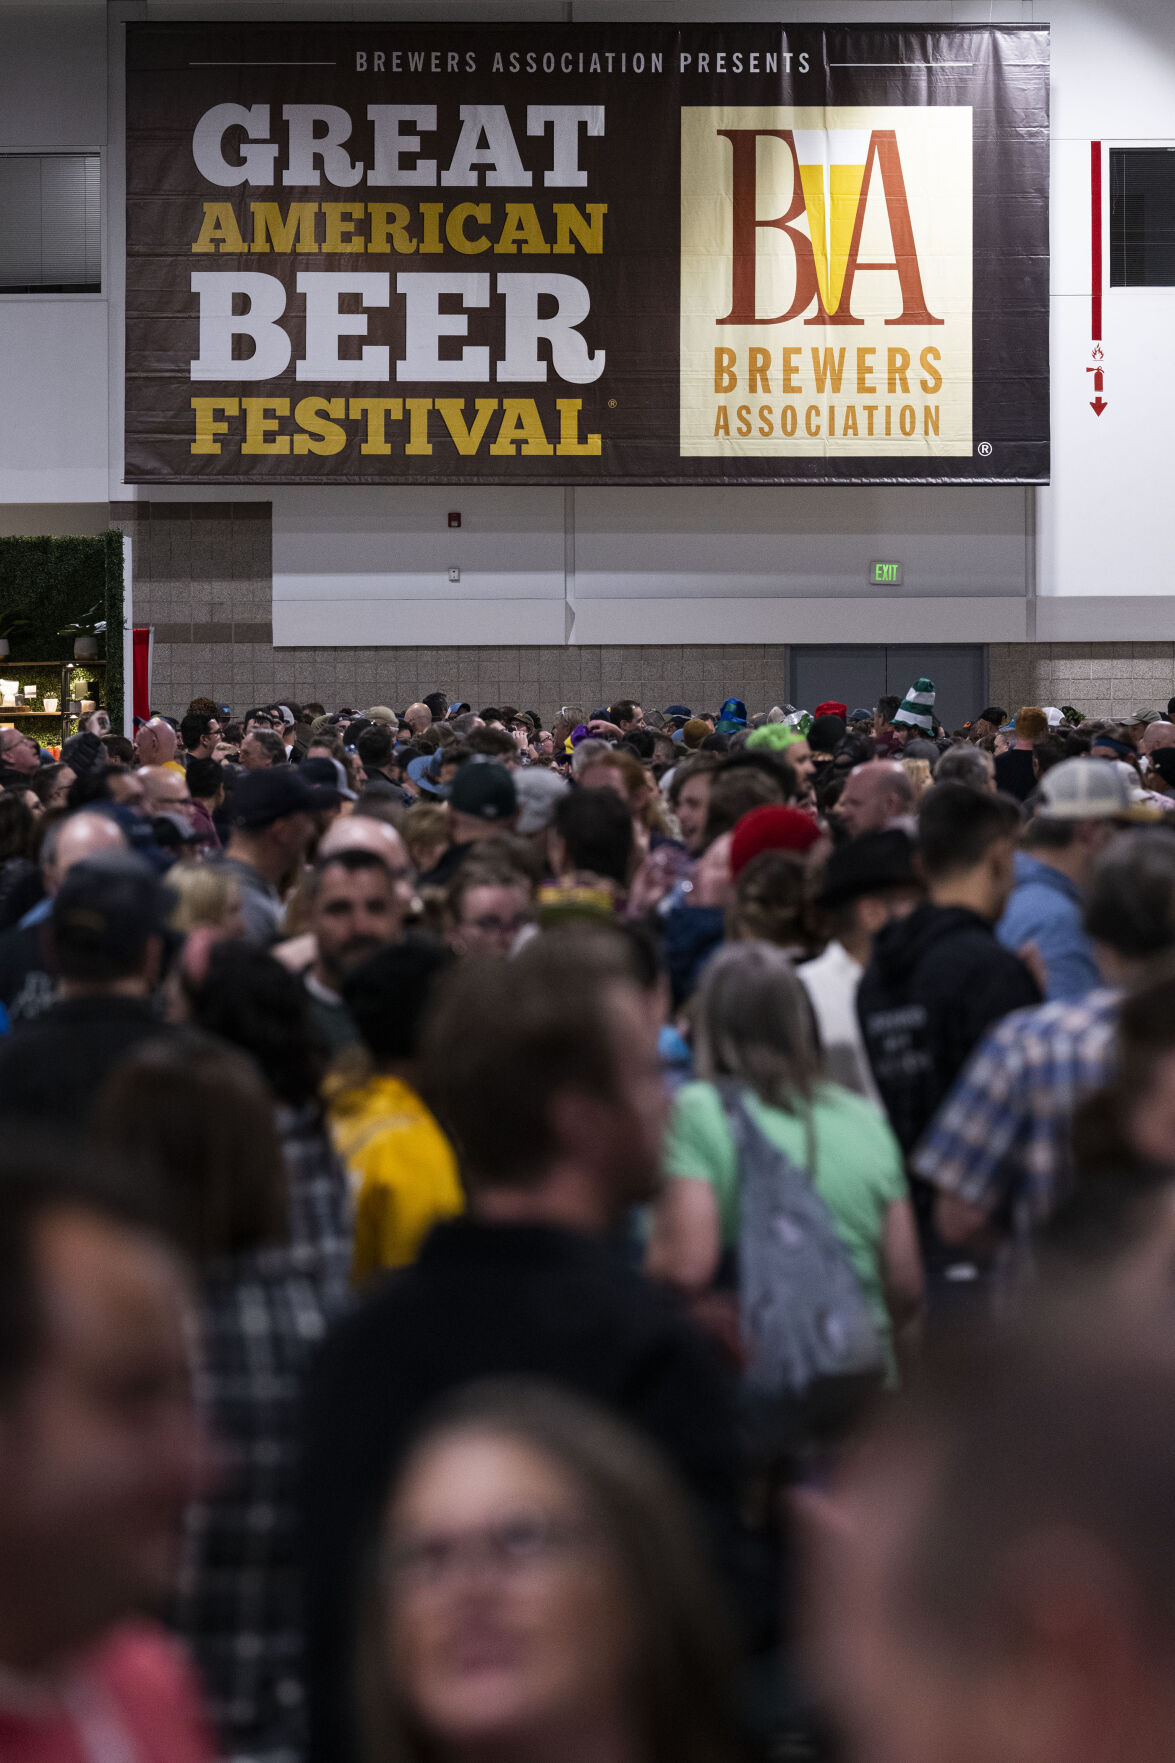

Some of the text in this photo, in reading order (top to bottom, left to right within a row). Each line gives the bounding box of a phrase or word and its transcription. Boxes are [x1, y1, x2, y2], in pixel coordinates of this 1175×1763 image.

[355, 51, 810, 73] BREWERS ASSOCIATION PRESENTS
[192, 102, 606, 188] GREAT
[191, 202, 608, 255] AMERICAN
[715, 129, 945, 325] BA
[190, 271, 606, 384] BEER
[713, 346, 943, 394] BREWERS
[190, 396, 602, 456] FESTIVAL
[713, 404, 940, 437] ASSOCIATION
[875, 563, 898, 581] EXIT
